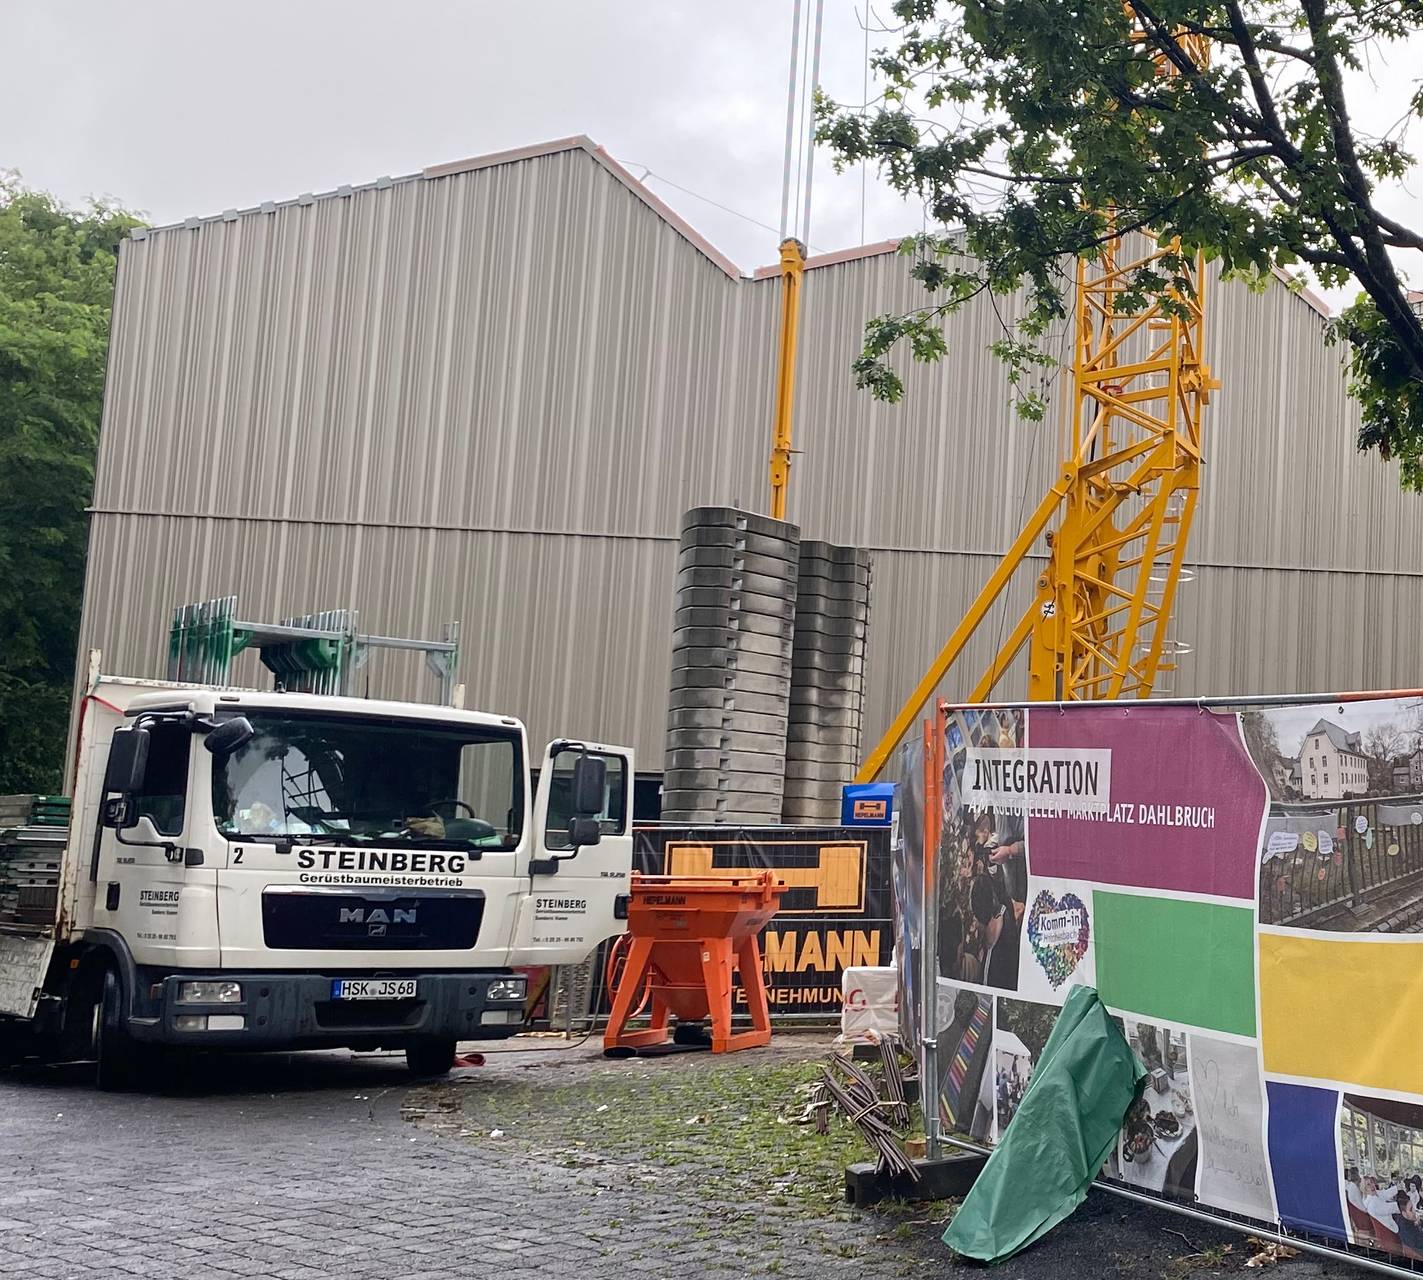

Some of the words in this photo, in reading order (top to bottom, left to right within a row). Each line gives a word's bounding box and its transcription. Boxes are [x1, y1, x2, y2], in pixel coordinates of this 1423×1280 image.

[972, 758, 1099, 796] INTEGRATION
[967, 799, 989, 815] AM
[1067, 801, 1135, 824] MARKTPLATZ
[1138, 803, 1215, 829] DAHLBRUCH
[233, 847, 244, 864] 2
[297, 849, 466, 873] STEINBERG
[299, 873, 463, 888] Gerüstbaumeisterbetrieb
[140, 890, 180, 901] STEINBERG
[536, 899, 587, 908] STEINBERG
[339, 907, 417, 924] MAN
[1040, 910, 1080, 931] Komm-in
[341, 981, 369, 996] HSK
